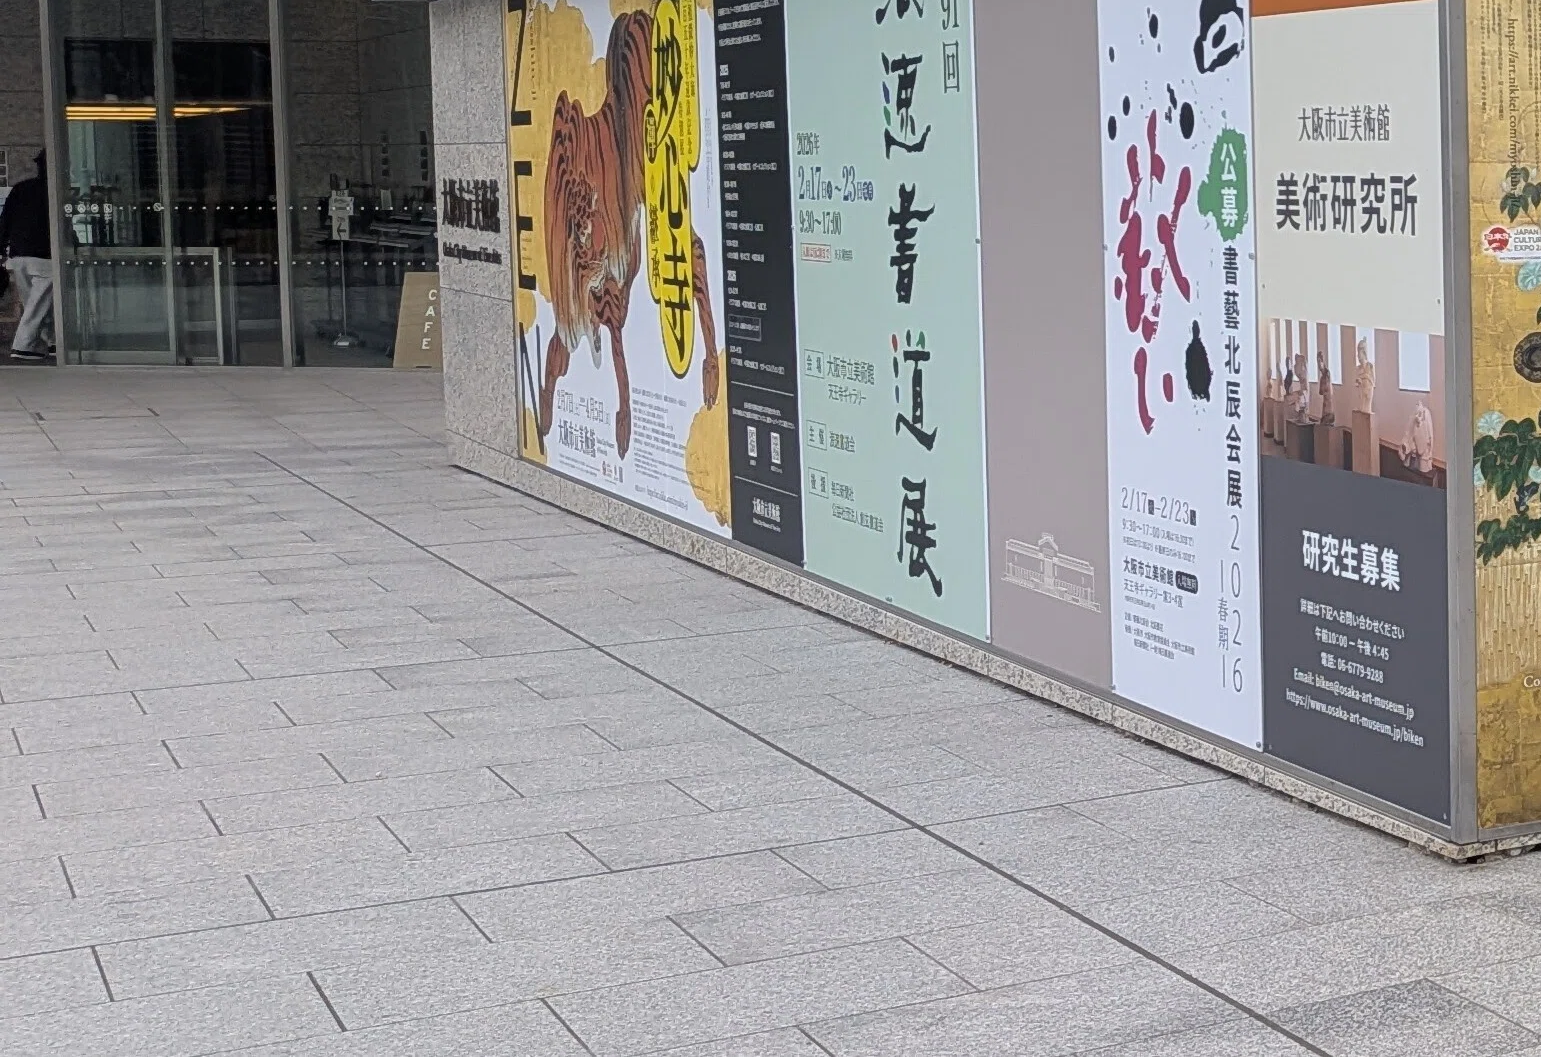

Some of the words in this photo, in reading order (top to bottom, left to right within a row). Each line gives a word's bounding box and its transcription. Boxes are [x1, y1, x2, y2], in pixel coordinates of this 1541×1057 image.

[1297, 103, 1391, 143] 大阪市立美術館
[653, 16, 692, 363] 妙心寺
[1220, 142, 1240, 228] 公募
[1275, 171, 1419, 237] 美術研究所
[1513, 228, 1539, 237] JAPAN
[1513, 244, 1535, 252] EXPO
[421, 289, 438, 350] CAFE
[827, 354, 875, 386] 大阪市立美術館
[1222, 245, 1243, 510] 書藝北辰会展
[1123, 556, 1174, 587] 大阪市立美術館
[1302, 529, 1401, 592] 研究生募集
